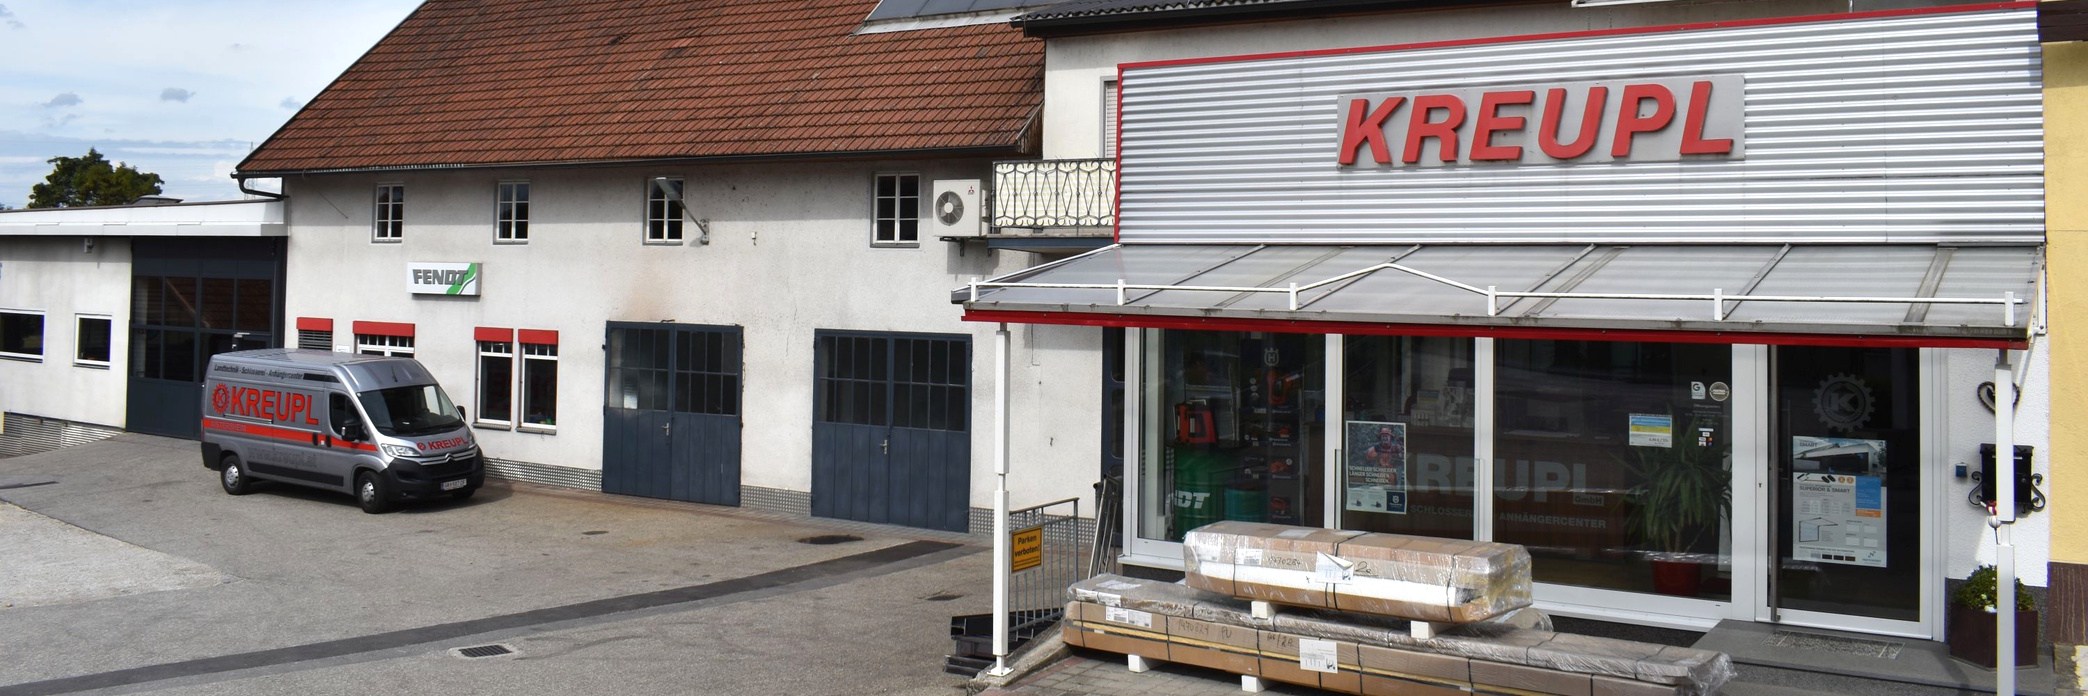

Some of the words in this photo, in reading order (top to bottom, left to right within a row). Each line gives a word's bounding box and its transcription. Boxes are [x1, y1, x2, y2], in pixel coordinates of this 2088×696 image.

[1338, 81, 1734, 164] KREUPL
[412, 269, 468, 285] FENDT
[230, 386, 319, 425] KREUPL
[428, 436, 469, 450] KREUPL
[1406, 453, 1604, 507] REUPL
[1410, 504, 1474, 518] SCHLOSSER
[1500, 512, 1606, 529] ANHÄNGERCENTER
[1018, 535, 1037, 544] Parken
